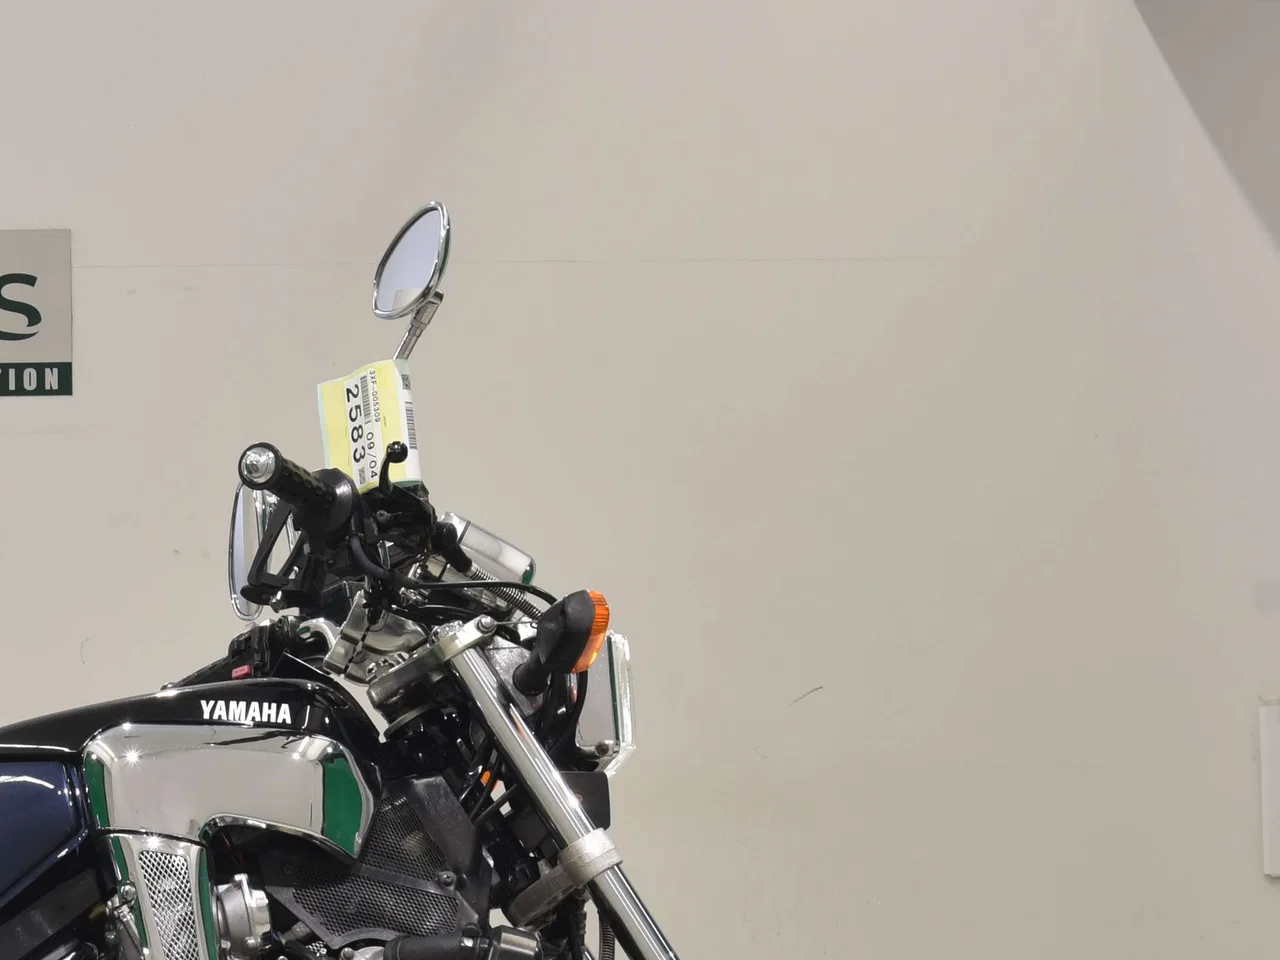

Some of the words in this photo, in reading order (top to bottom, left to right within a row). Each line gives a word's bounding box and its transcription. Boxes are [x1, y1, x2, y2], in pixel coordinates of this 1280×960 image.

[346, 384, 366, 463] 2583
[366, 432, 378, 479] 09/04
[200, 700, 292, 724] YAMAHA
